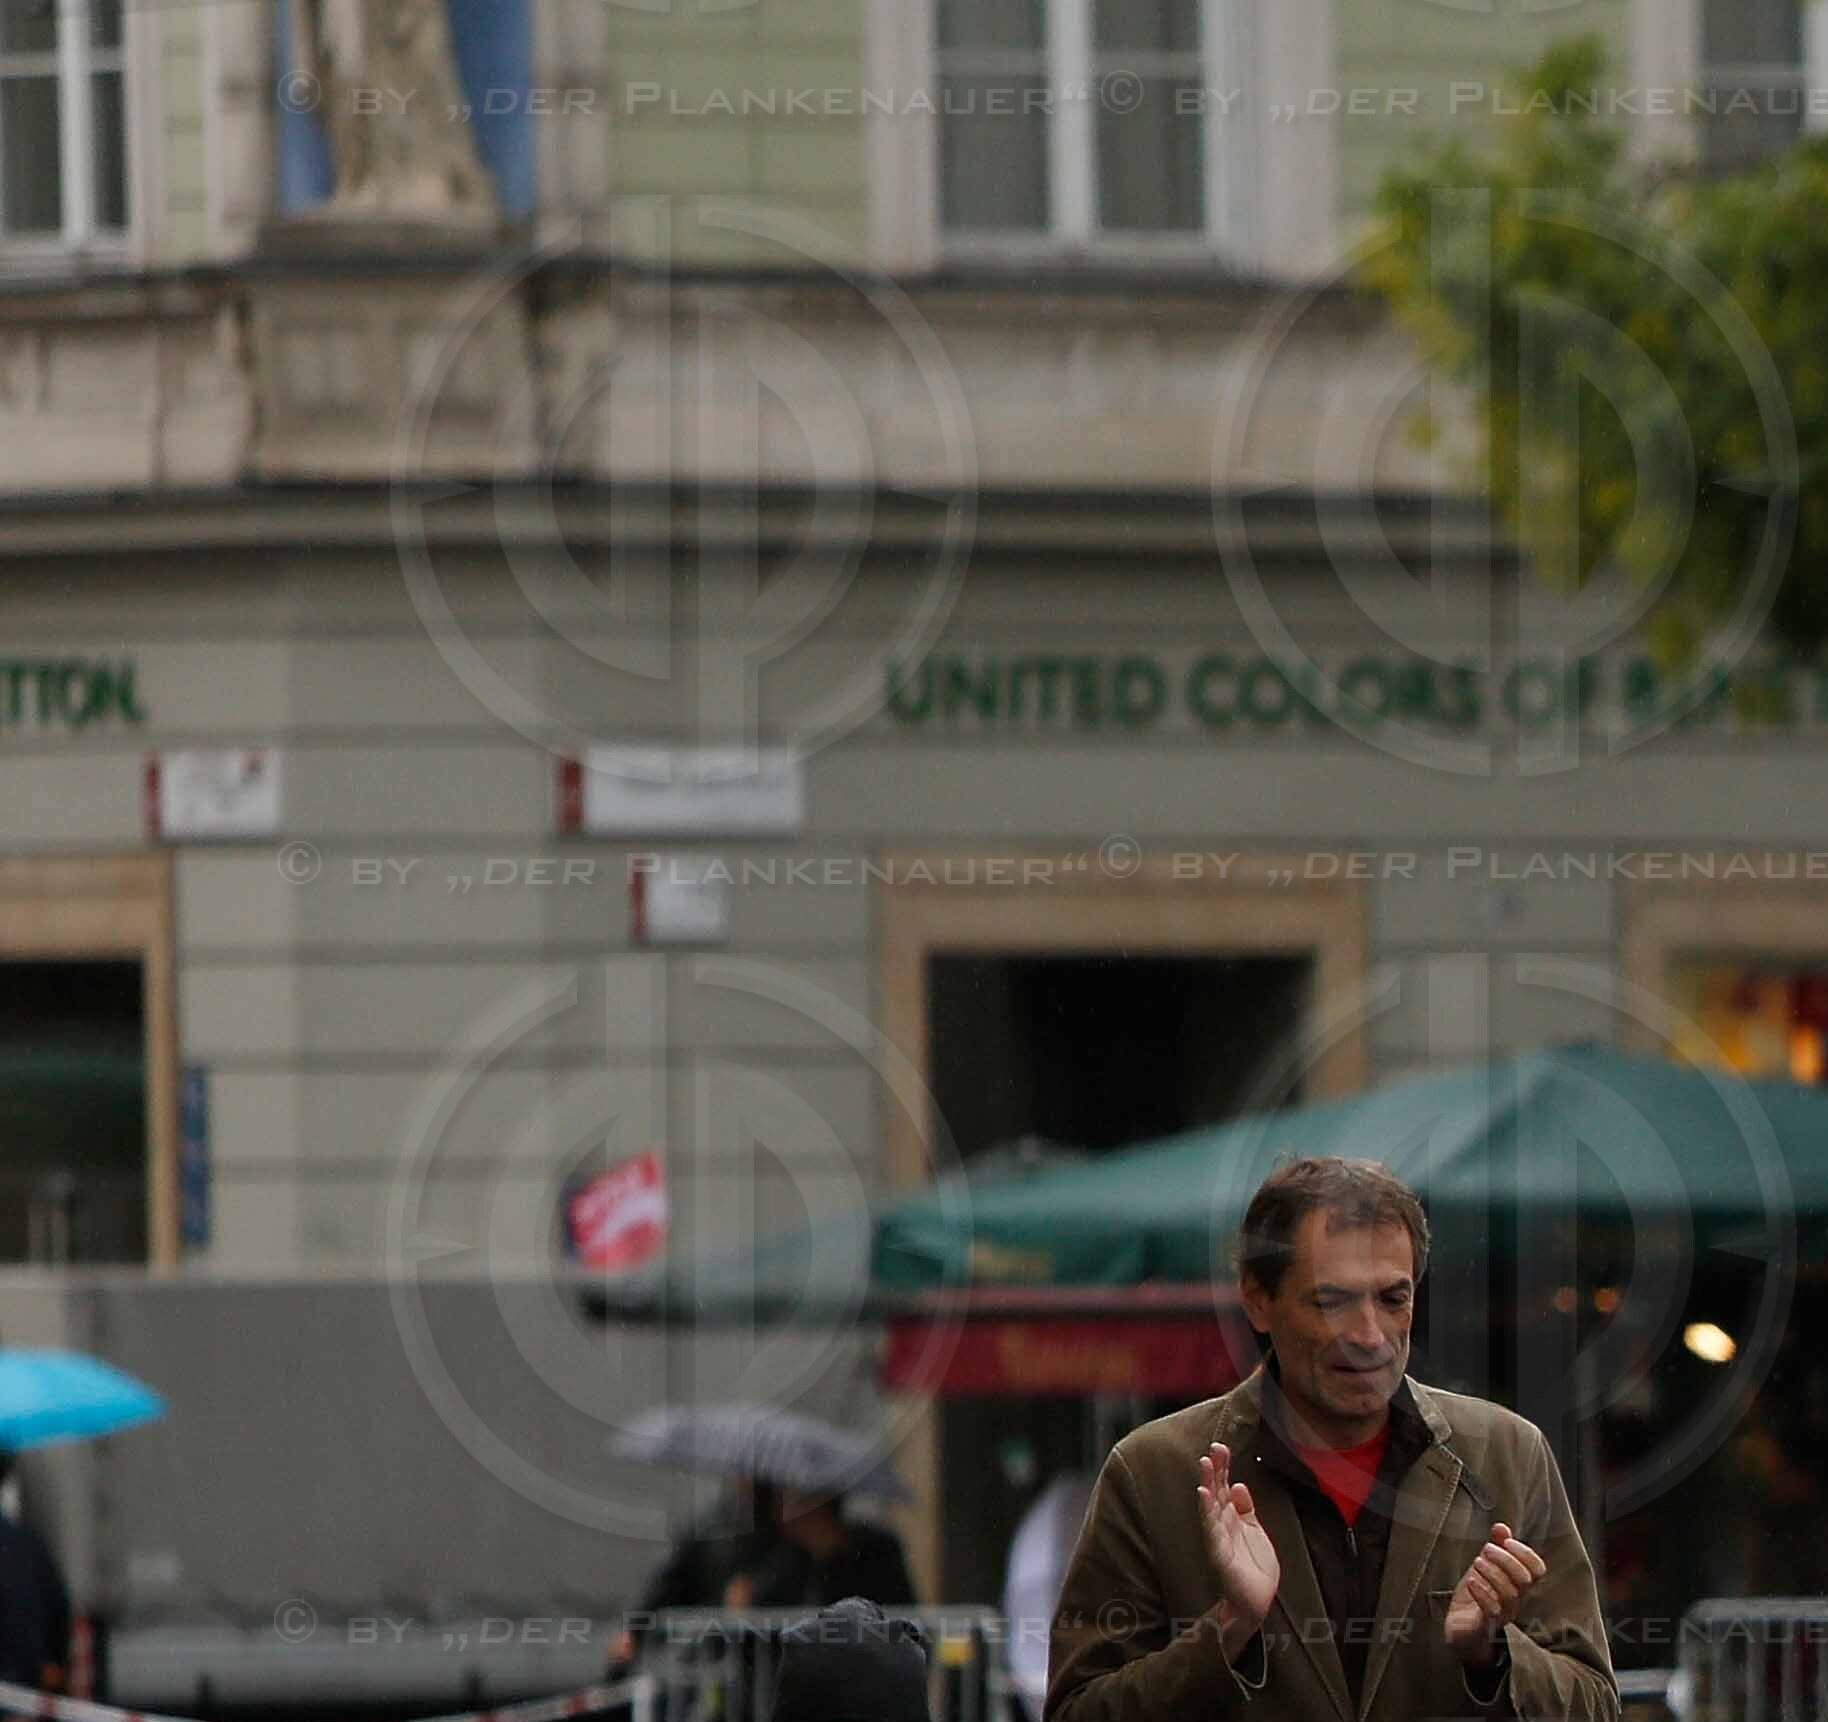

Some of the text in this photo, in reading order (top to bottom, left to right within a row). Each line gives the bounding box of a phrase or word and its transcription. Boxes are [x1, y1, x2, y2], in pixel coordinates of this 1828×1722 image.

[886, 653, 1168, 729] UNITED
[1187, 654, 1484, 731] COLORS
[1505, 655, 1602, 731] OF
